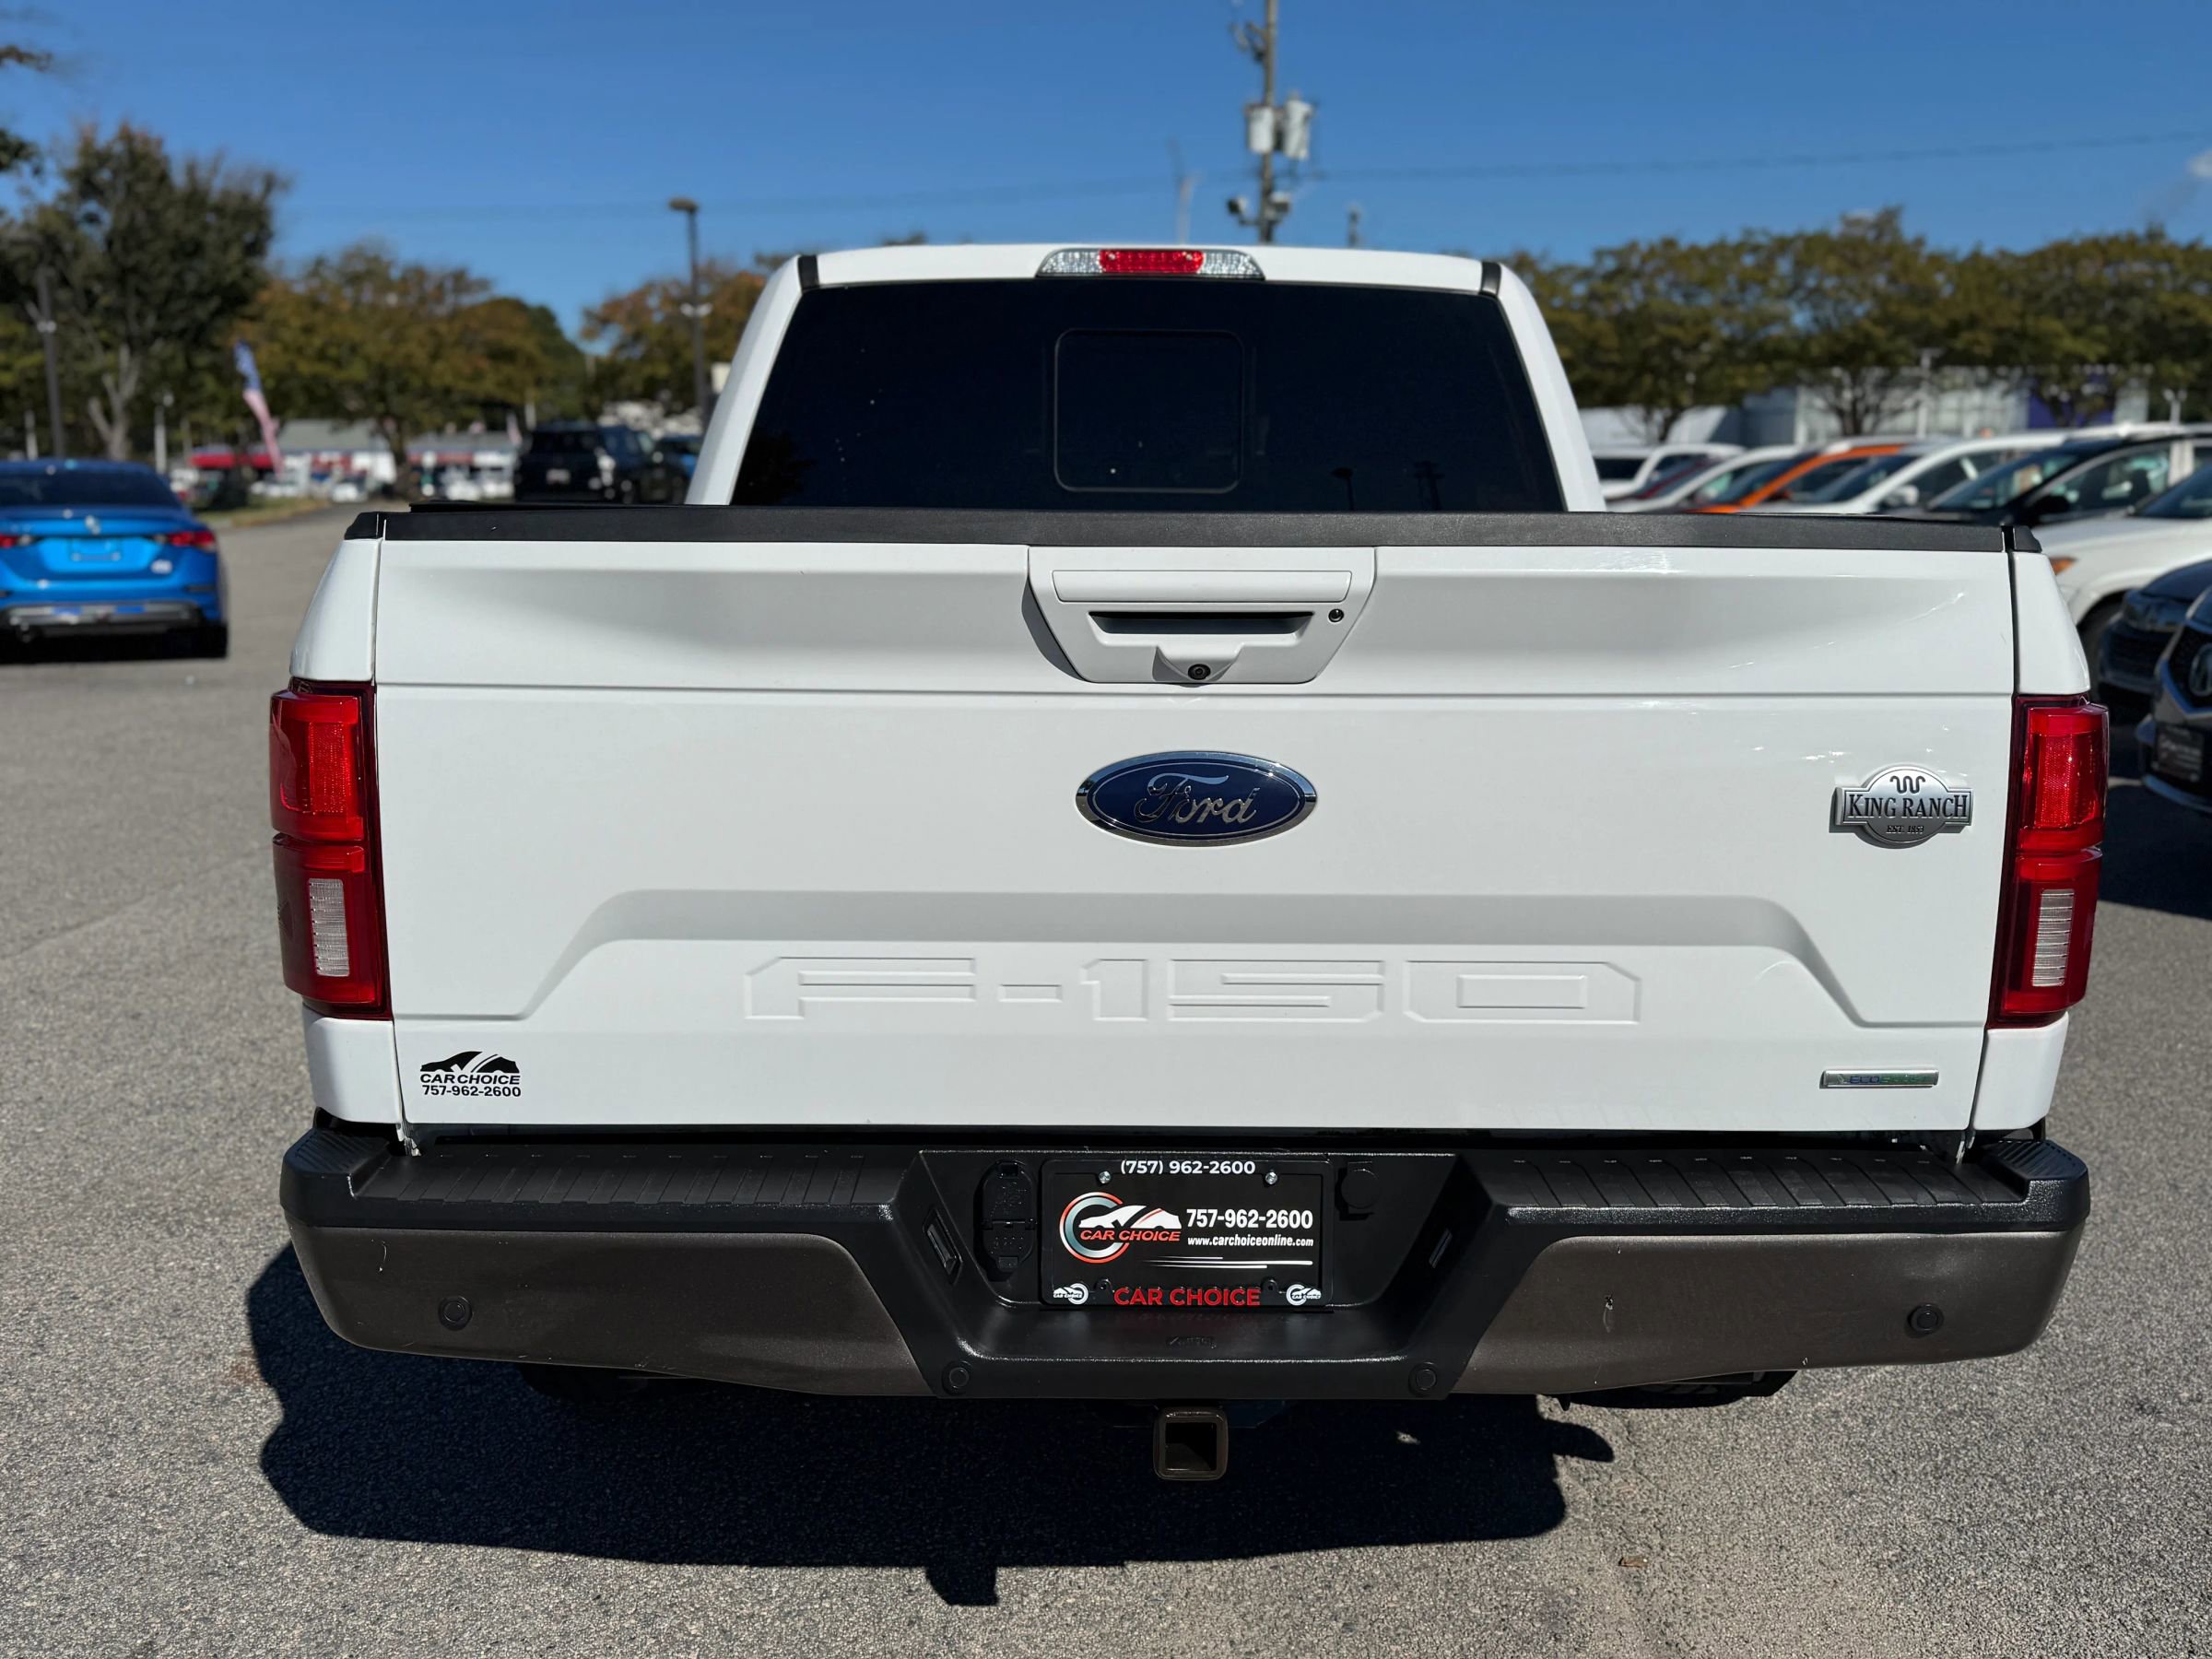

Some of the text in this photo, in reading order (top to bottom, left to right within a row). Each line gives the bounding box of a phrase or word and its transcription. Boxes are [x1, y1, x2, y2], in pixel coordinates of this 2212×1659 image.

[1134, 772, 1260, 824] Ford
[1848, 794, 1969, 818] KING RANCH
[745, 956, 1641, 1025] F-150
[419, 1074, 521, 1085] CAR CHOICE
[421, 1085, 522, 1098] 757-962-2600
[1121, 1160, 1256, 1175] (757) 962-2600
[1186, 1208, 1313, 1230] 757-962-2600
[1080, 1230, 1181, 1242] CAR CHOICE
[1187, 1233, 1314, 1247] www.carchoiceonline.com
[1113, 1288, 1262, 1307] CAR CHOICE
